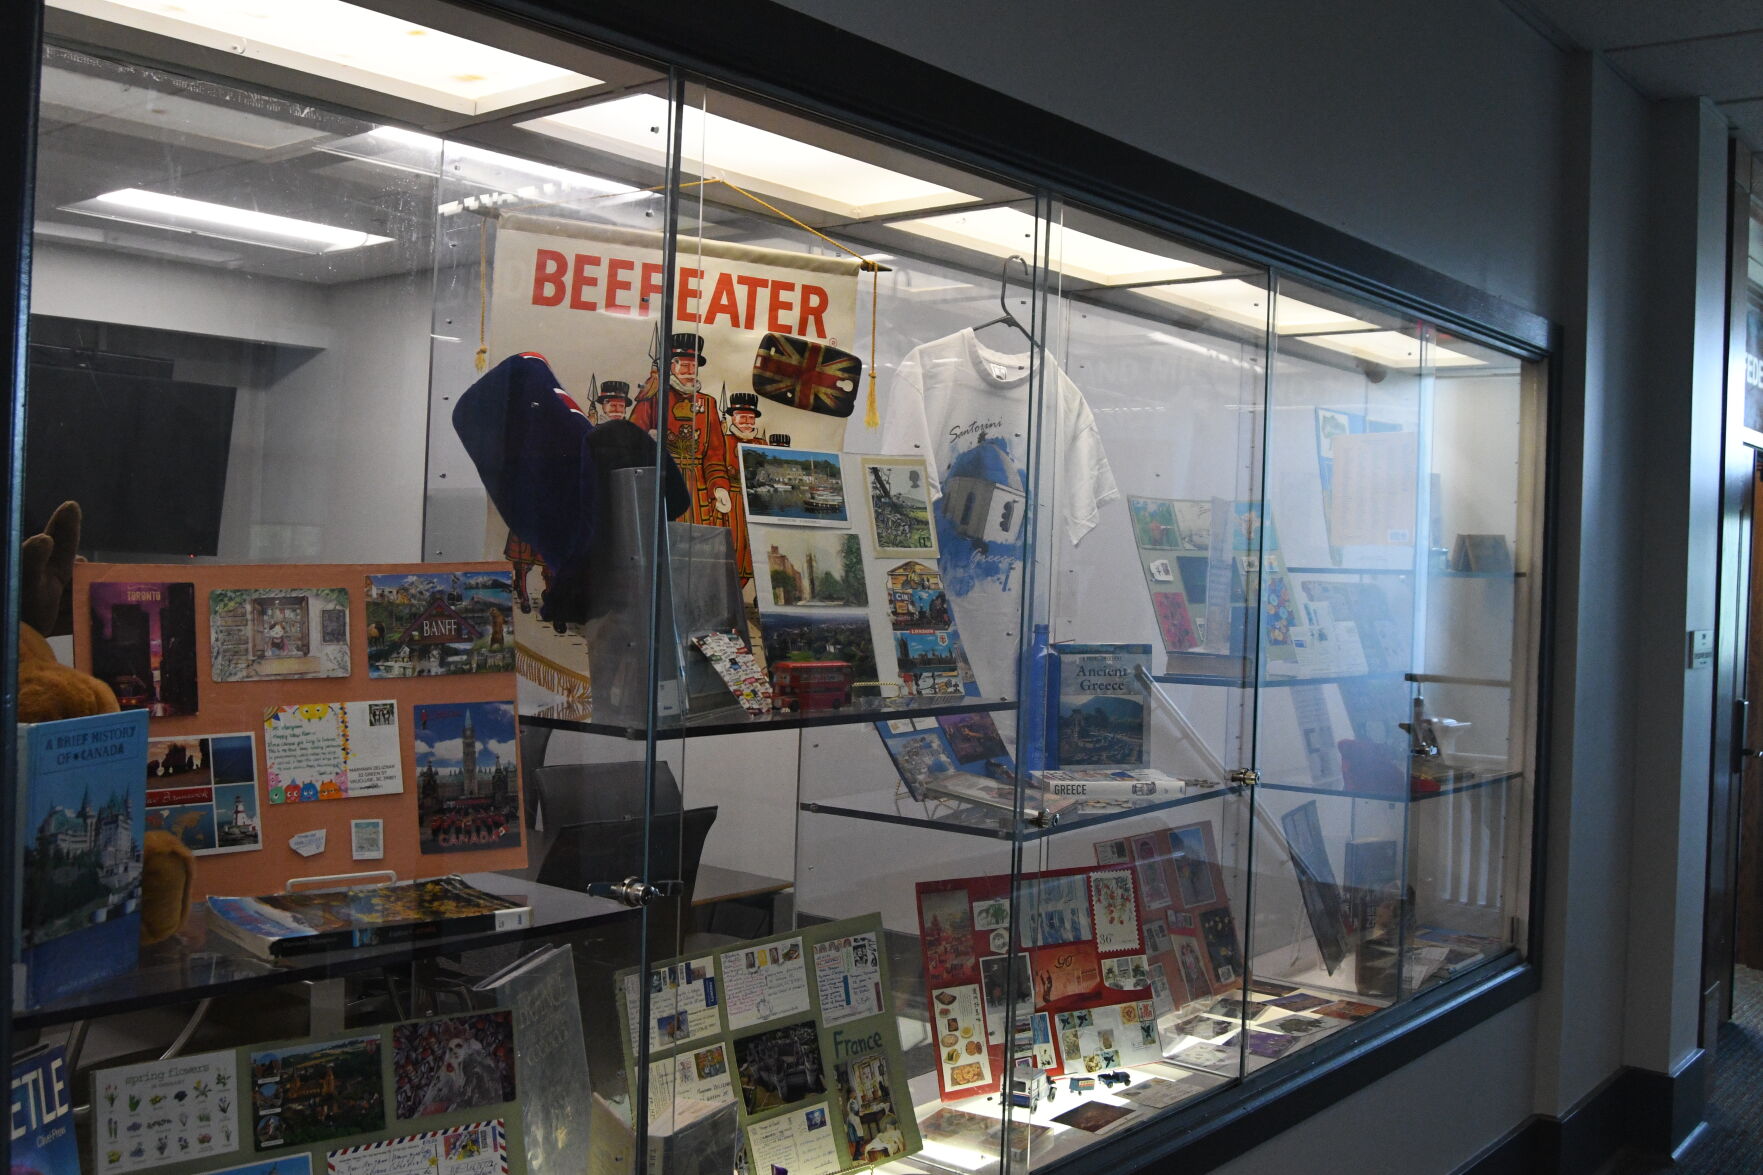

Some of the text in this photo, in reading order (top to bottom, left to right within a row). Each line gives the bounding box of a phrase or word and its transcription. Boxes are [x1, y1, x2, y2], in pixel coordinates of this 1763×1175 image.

[531, 248, 829, 339] BEEFEATER
[949, 417, 1003, 444] Santorini
[127, 591, 161, 601] TORONTO
[423, 619, 457, 637] BANFF
[1076, 665, 1128, 677] Ancient
[1080, 680, 1125, 692] Greece
[45, 725, 137, 750] A BRIEF HISTORY
[57, 743, 125, 766] OF CANADA
[1054, 784, 1087, 796] GREECE
[438, 830, 500, 848] CANADA
[833, 1030, 883, 1059] France
[125, 1063, 210, 1089] spring flowers
[10, 1057, 70, 1141] ETLE
